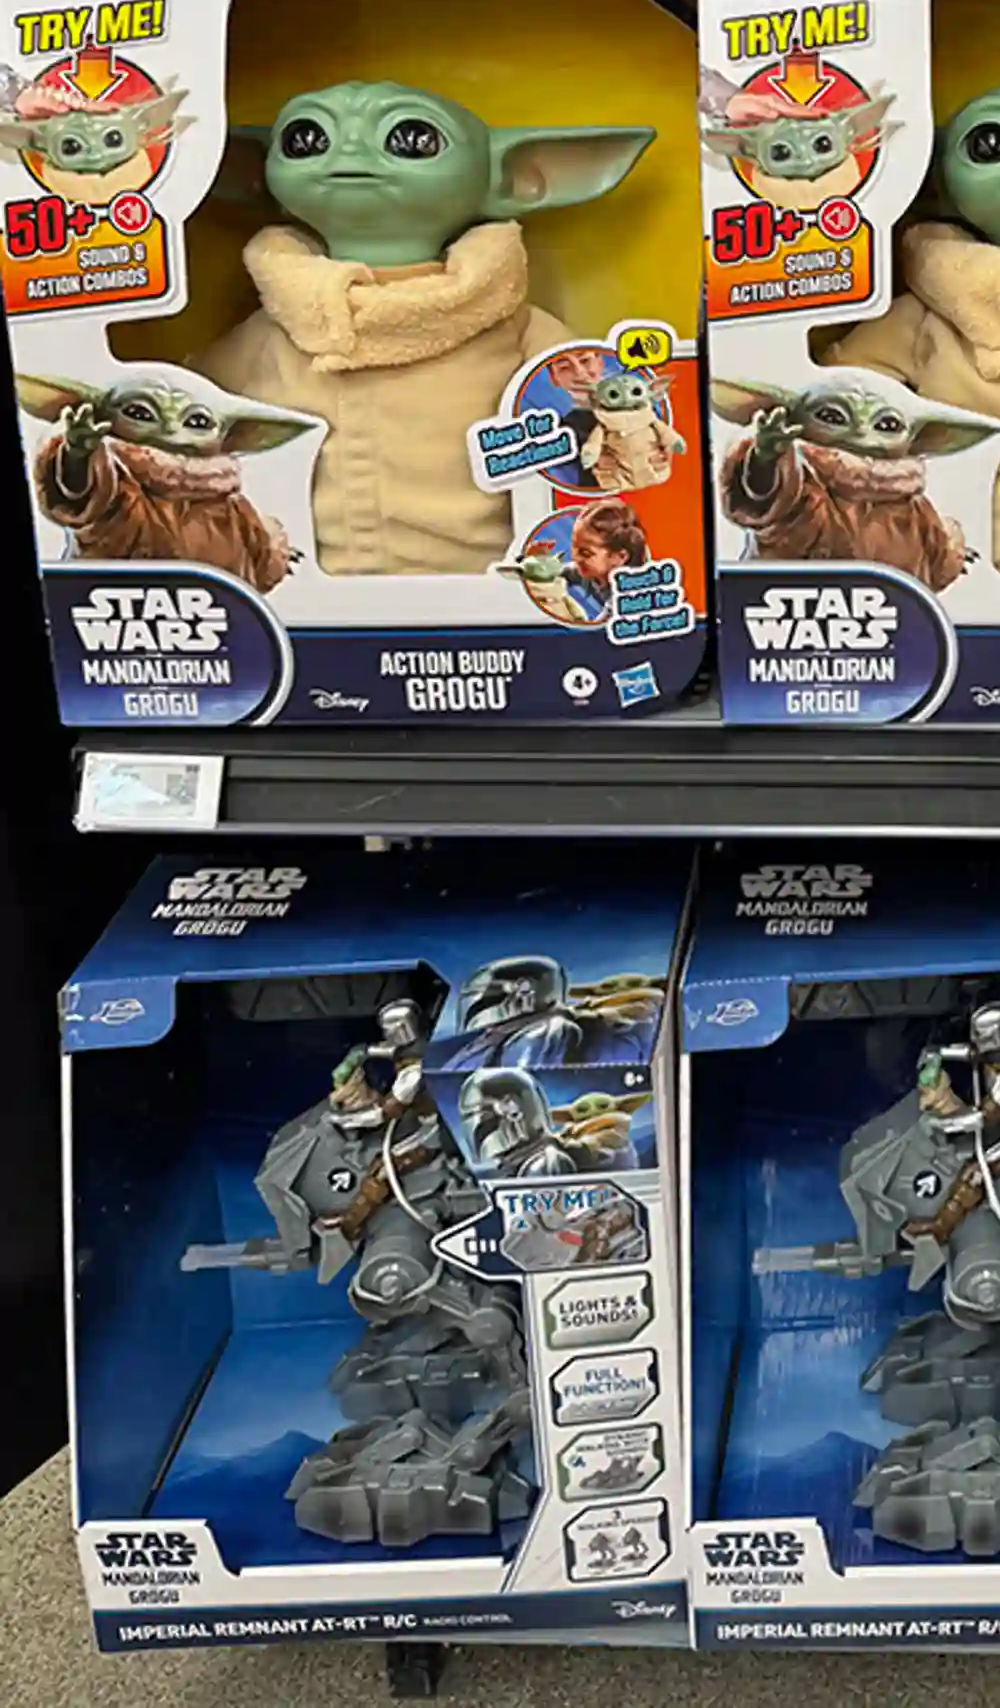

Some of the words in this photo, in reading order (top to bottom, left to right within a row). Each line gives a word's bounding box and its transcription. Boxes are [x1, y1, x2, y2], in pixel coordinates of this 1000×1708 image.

[17, 10, 91, 54] TRY
[723, 15, 797, 60] TRY
[801, 2, 869, 46] ME!
[6, 197, 97, 258] 50+
[713, 202, 803, 263] 50+
[78, 244, 130, 270] SOUND
[26, 275, 83, 300] ACTION
[85, 266, 148, 294] COMBOS
[729, 282, 785, 305] ACTION
[788, 272, 852, 298] COMBOS
[71, 587, 228, 619] STAR
[74, 617, 228, 652] WARS
[83, 659, 231, 685] MANDALORIAN
[380, 651, 454, 677] ACTION
[459, 650, 525, 677] BUDDY
[123, 692, 199, 717] GROGU
[503, 1194, 558, 1215] TRY
[558, 1298, 621, 1316] LIGHTS
[623, 1295, 638, 1311] &
[560, 1308, 639, 1327] SOUNDS!
[586, 1367, 622, 1381] FULL
[562, 1378, 648, 1399] FUNCTION!
[95, 1532, 198, 1554] STAR
[703, 1531, 804, 1552] STAR
[97, 1548, 197, 1569] WARS
[705, 1547, 803, 1568] WARS
[101, 1569, 201, 1587] MANDALORIAN
[128, 1589, 180, 1604] GROGU
[612, 1599, 679, 1619] Disney
[119, 1622, 212, 1643] IMPERIAL
[213, 1617, 310, 1638] REMNANT
[383, 1613, 418, 1631] R/C
